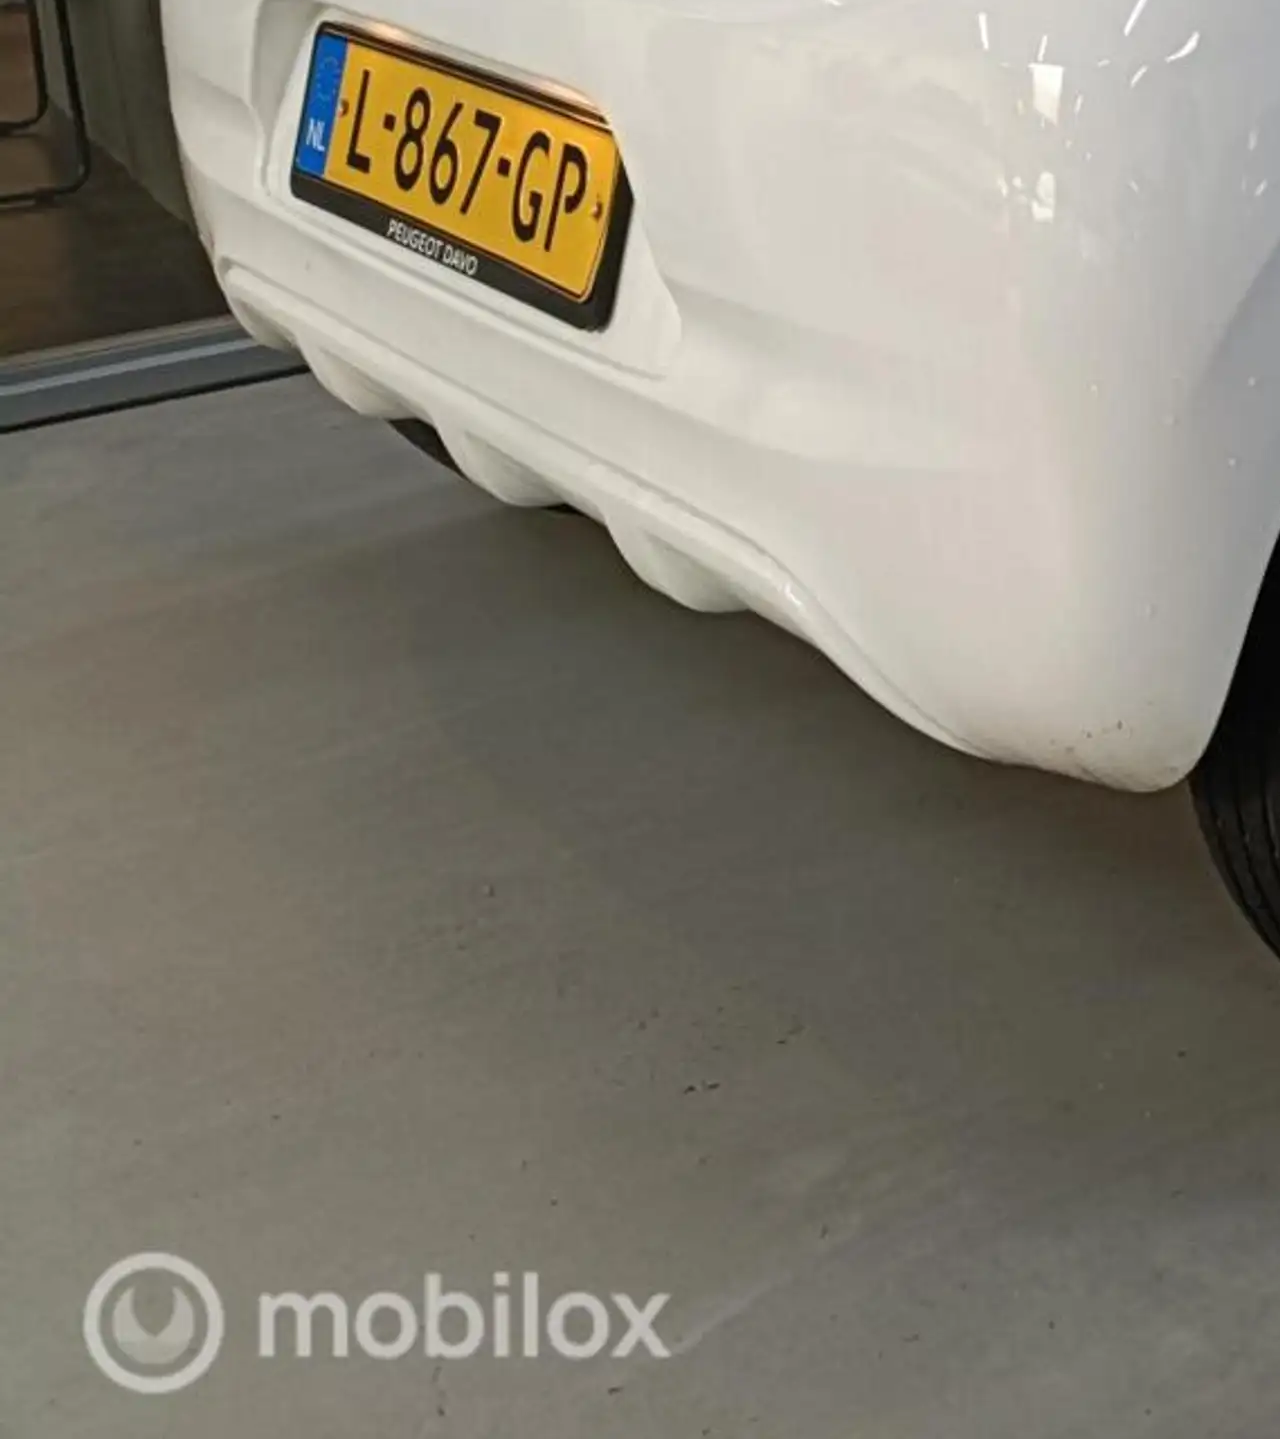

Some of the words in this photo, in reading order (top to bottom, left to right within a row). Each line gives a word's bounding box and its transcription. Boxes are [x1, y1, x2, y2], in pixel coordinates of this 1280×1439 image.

[305, 117, 326, 153] NL
[346, 69, 588, 252] L-867-GP
[387, 219, 442, 257] PEUGEOT
[443, 245, 478, 275] DAVO
